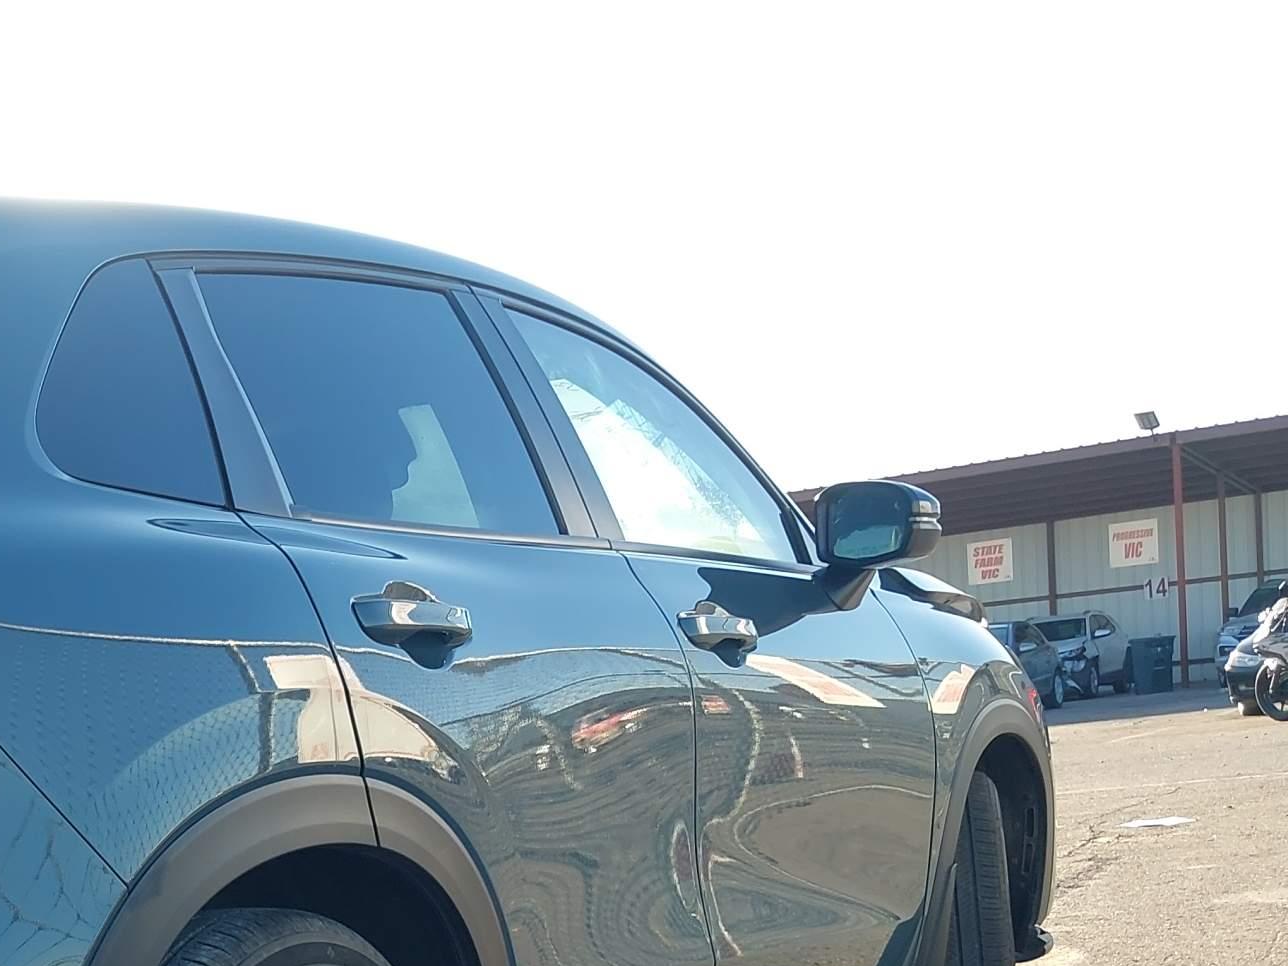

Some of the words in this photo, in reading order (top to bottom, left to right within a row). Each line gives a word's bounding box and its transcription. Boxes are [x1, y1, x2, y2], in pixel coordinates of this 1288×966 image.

[972, 544, 1004, 557] STATE
[1124, 541, 1143, 560] VIC
[974, 555, 1004, 569] FARM
[981, 568, 1000, 580] VIC
[1143, 577, 1168, 599] 14
